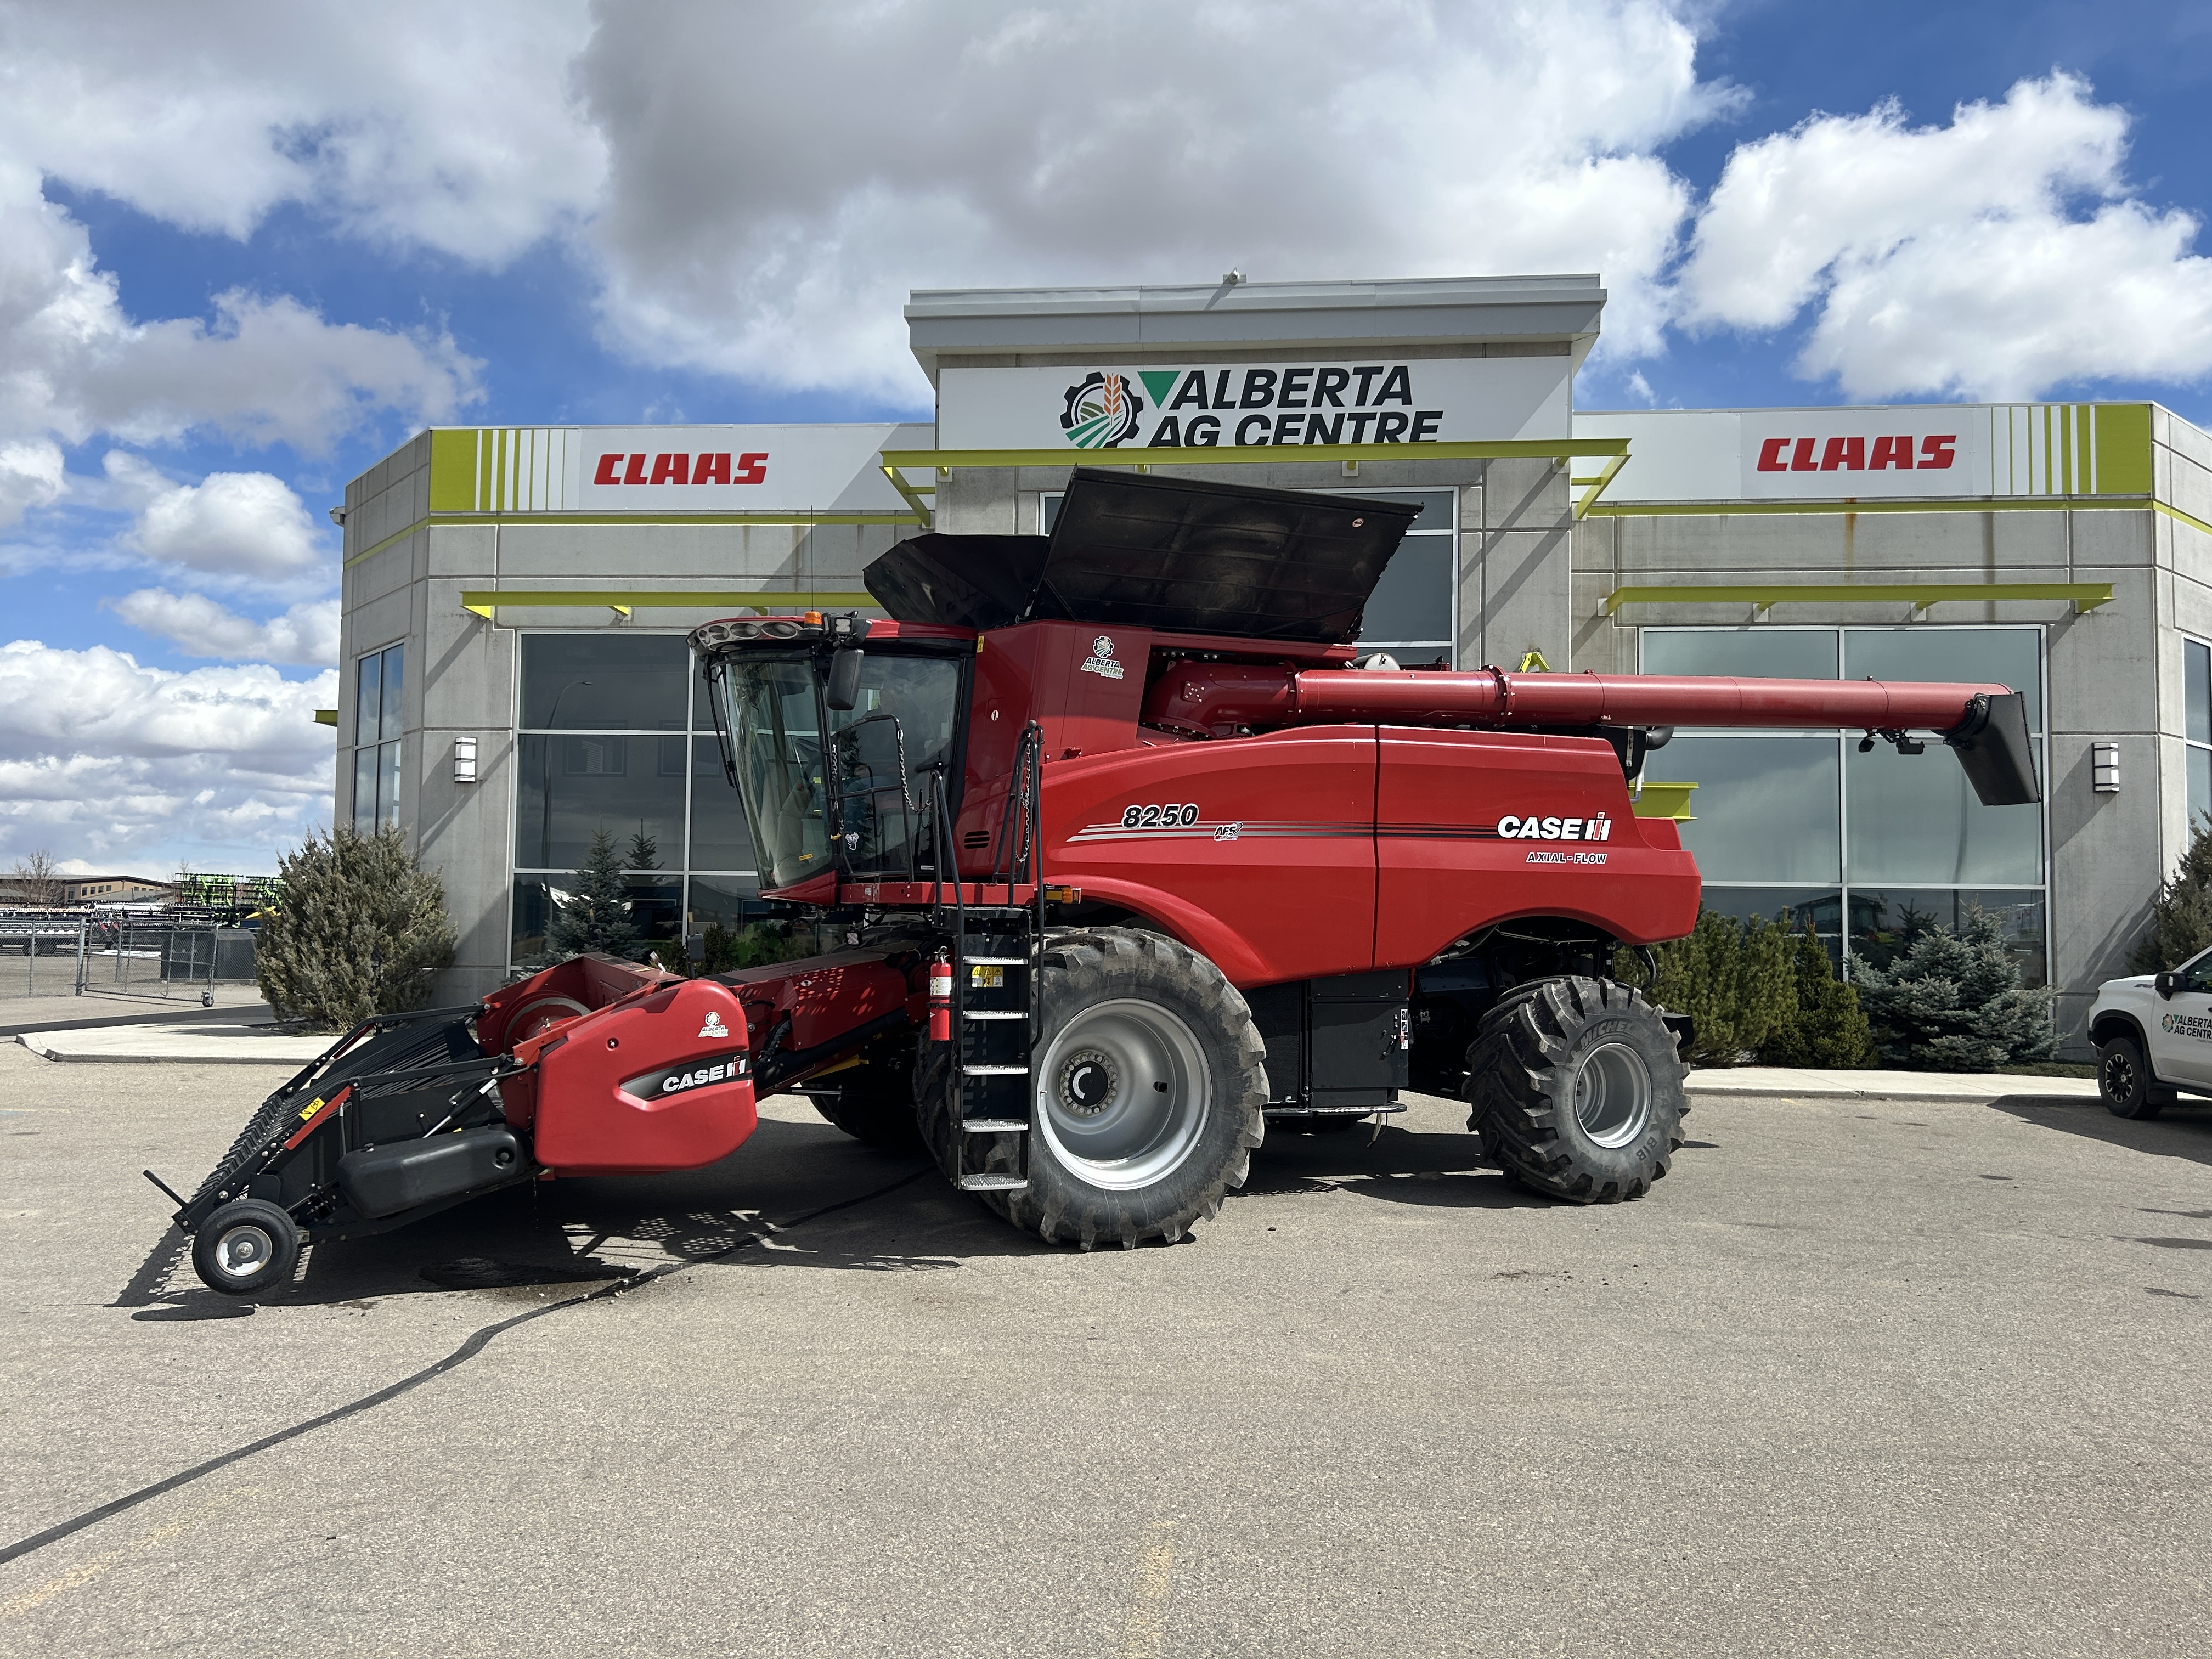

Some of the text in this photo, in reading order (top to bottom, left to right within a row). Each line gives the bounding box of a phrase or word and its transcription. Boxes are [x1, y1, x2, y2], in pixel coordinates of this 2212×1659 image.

[1168, 365, 1413, 410] ALBERTA
[1147, 410, 1444, 448] AG CENTRE
[1756, 435, 1957, 472] CLAAS
[593, 453, 769, 485] CLAAS
[1086, 658, 1120, 668] ALBERTA
[1094, 665, 1123, 675] CENTRE
[1122, 804, 1199, 828] 8250
[1497, 816, 1583, 839] CASE
[1215, 826, 1237, 836] AFS
[1526, 852, 1607, 865] AXIAL-FLOW
[2174, 1025, 2212, 1040] AG CENTR
[2177, 1015, 2212, 1030] ALBERTA
[663, 1065, 724, 1092] CASE
